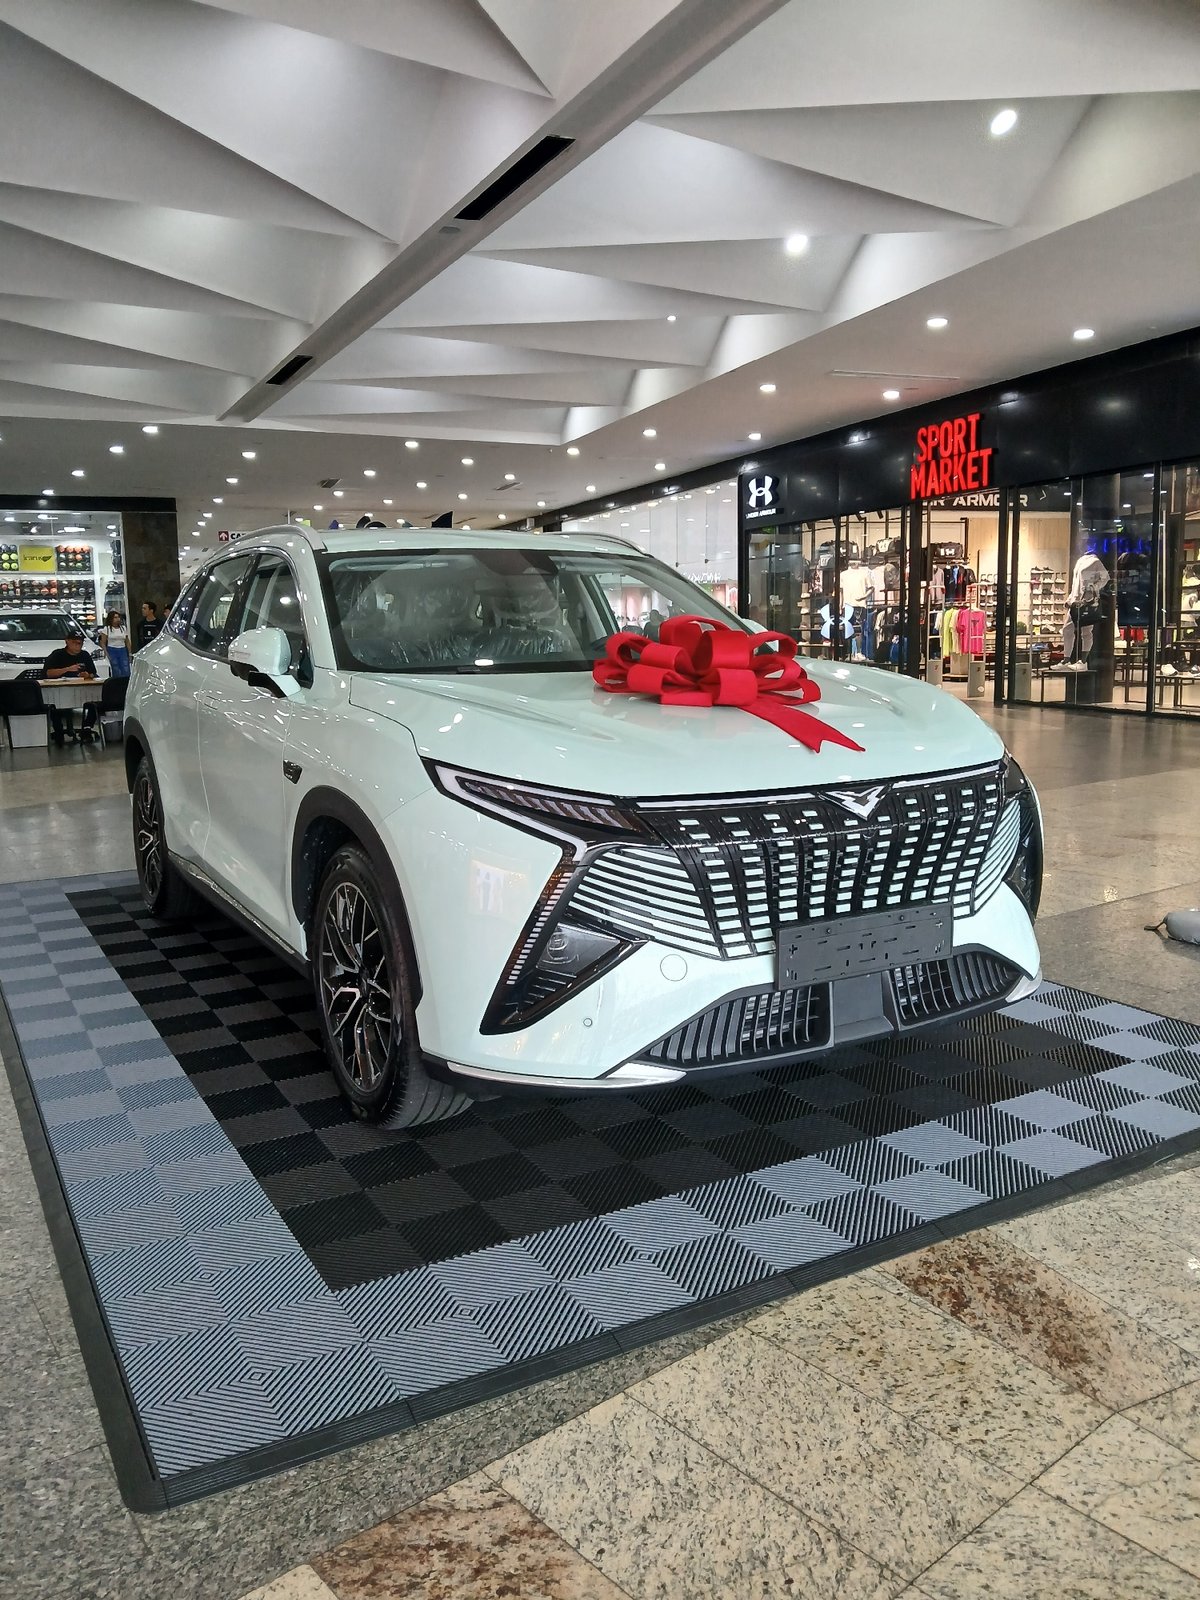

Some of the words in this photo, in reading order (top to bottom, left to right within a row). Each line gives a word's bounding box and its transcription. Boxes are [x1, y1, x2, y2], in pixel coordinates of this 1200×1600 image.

[917, 413, 980, 463] SPORT
[910, 448, 992, 500] MARKET
[952, 494, 1029, 507] ARMOR
